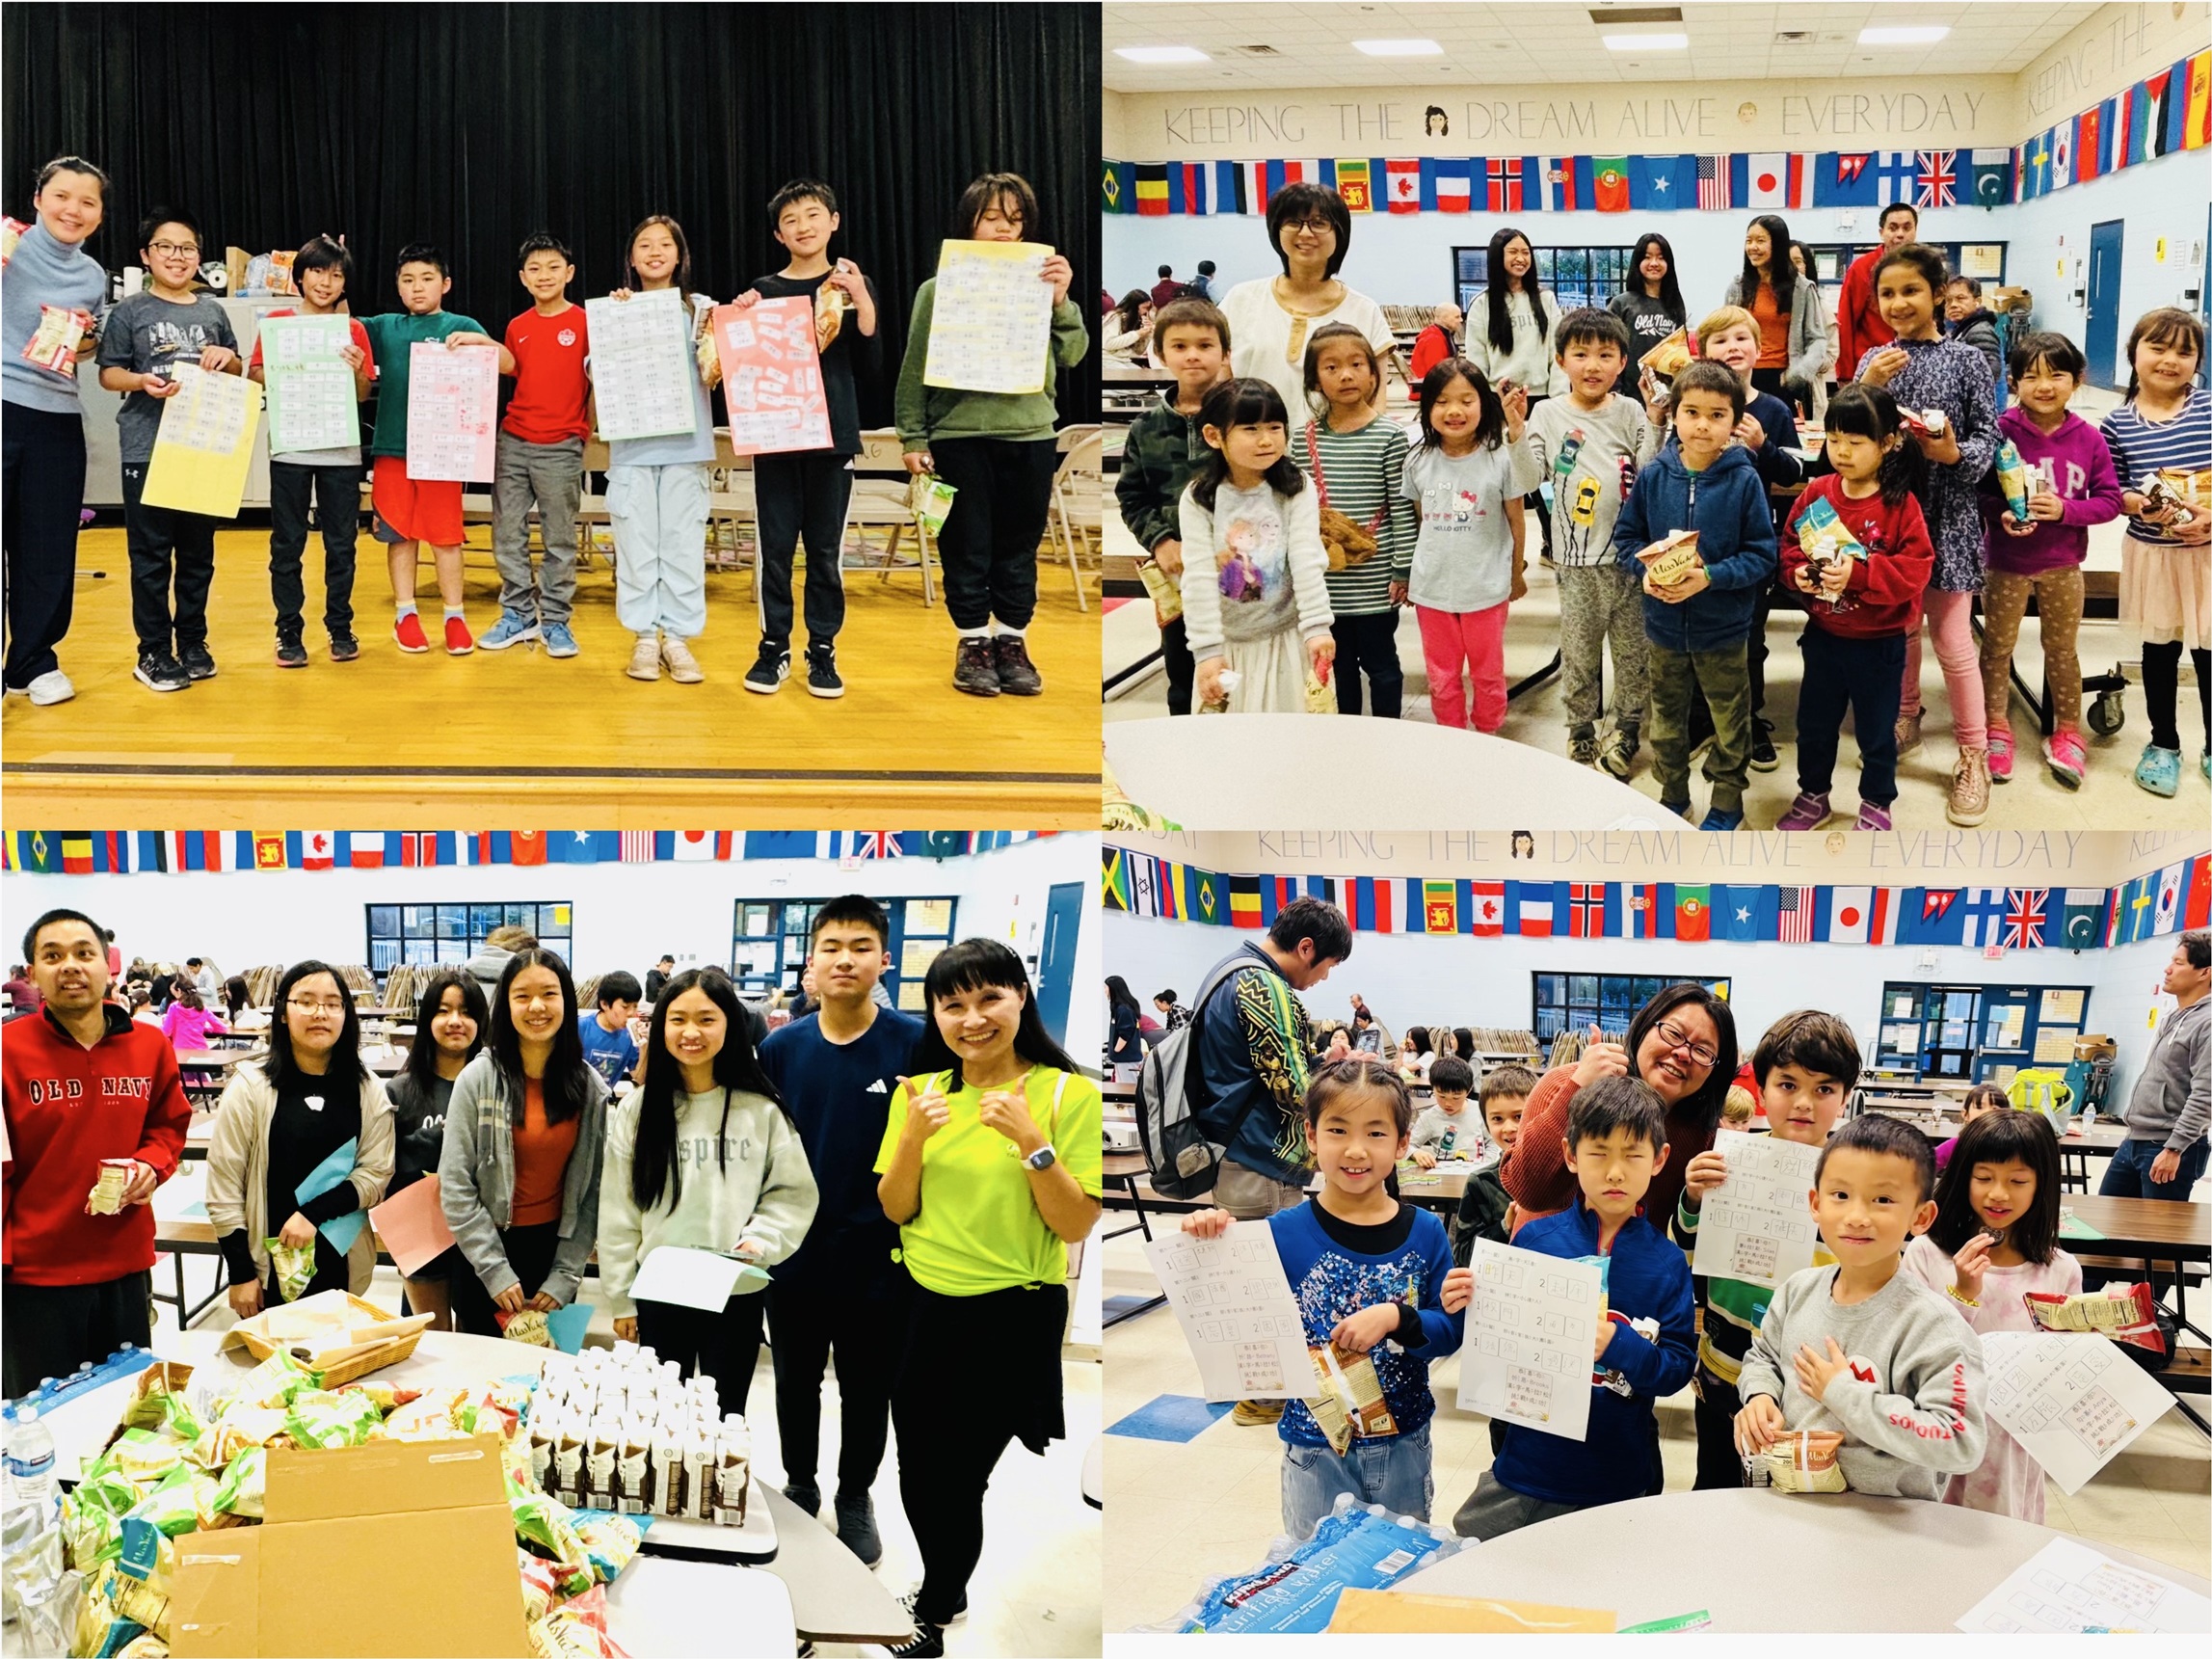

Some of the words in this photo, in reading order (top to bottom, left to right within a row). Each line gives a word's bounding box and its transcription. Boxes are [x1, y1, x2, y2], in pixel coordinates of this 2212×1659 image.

[1164, 104, 1305, 145] KEEPING
[1329, 102, 1404, 142] THE
[1466, 100, 1598, 141] DREAM
[1617, 97, 1718, 138] ALIVE
[1782, 92, 1985, 136] EVERYDAY
[1635, 314, 1654, 330] Old
[2039, 456, 2087, 499] AP
[1258, 831, 1394, 860] KEEPING
[1701, 831, 1802, 868] ALIVE
[1870, 831, 2084, 869] EVERYDAY
[29, 1079, 83, 1106] OLD
[679, 1137, 751, 1170] spire
[1539, 1278, 1545, 1288] 2
[1536, 1317, 1542, 1325] 2
[1533, 1352, 1540, 1362] 2
[2036, 1353, 2044, 1363] 2
[2065, 1381, 2075, 1391] 2
[1889, 1413, 1952, 1439] TUDIOS
[1227, 1587, 1292, 1632] urified
[1291, 1552, 1339, 1587] water
